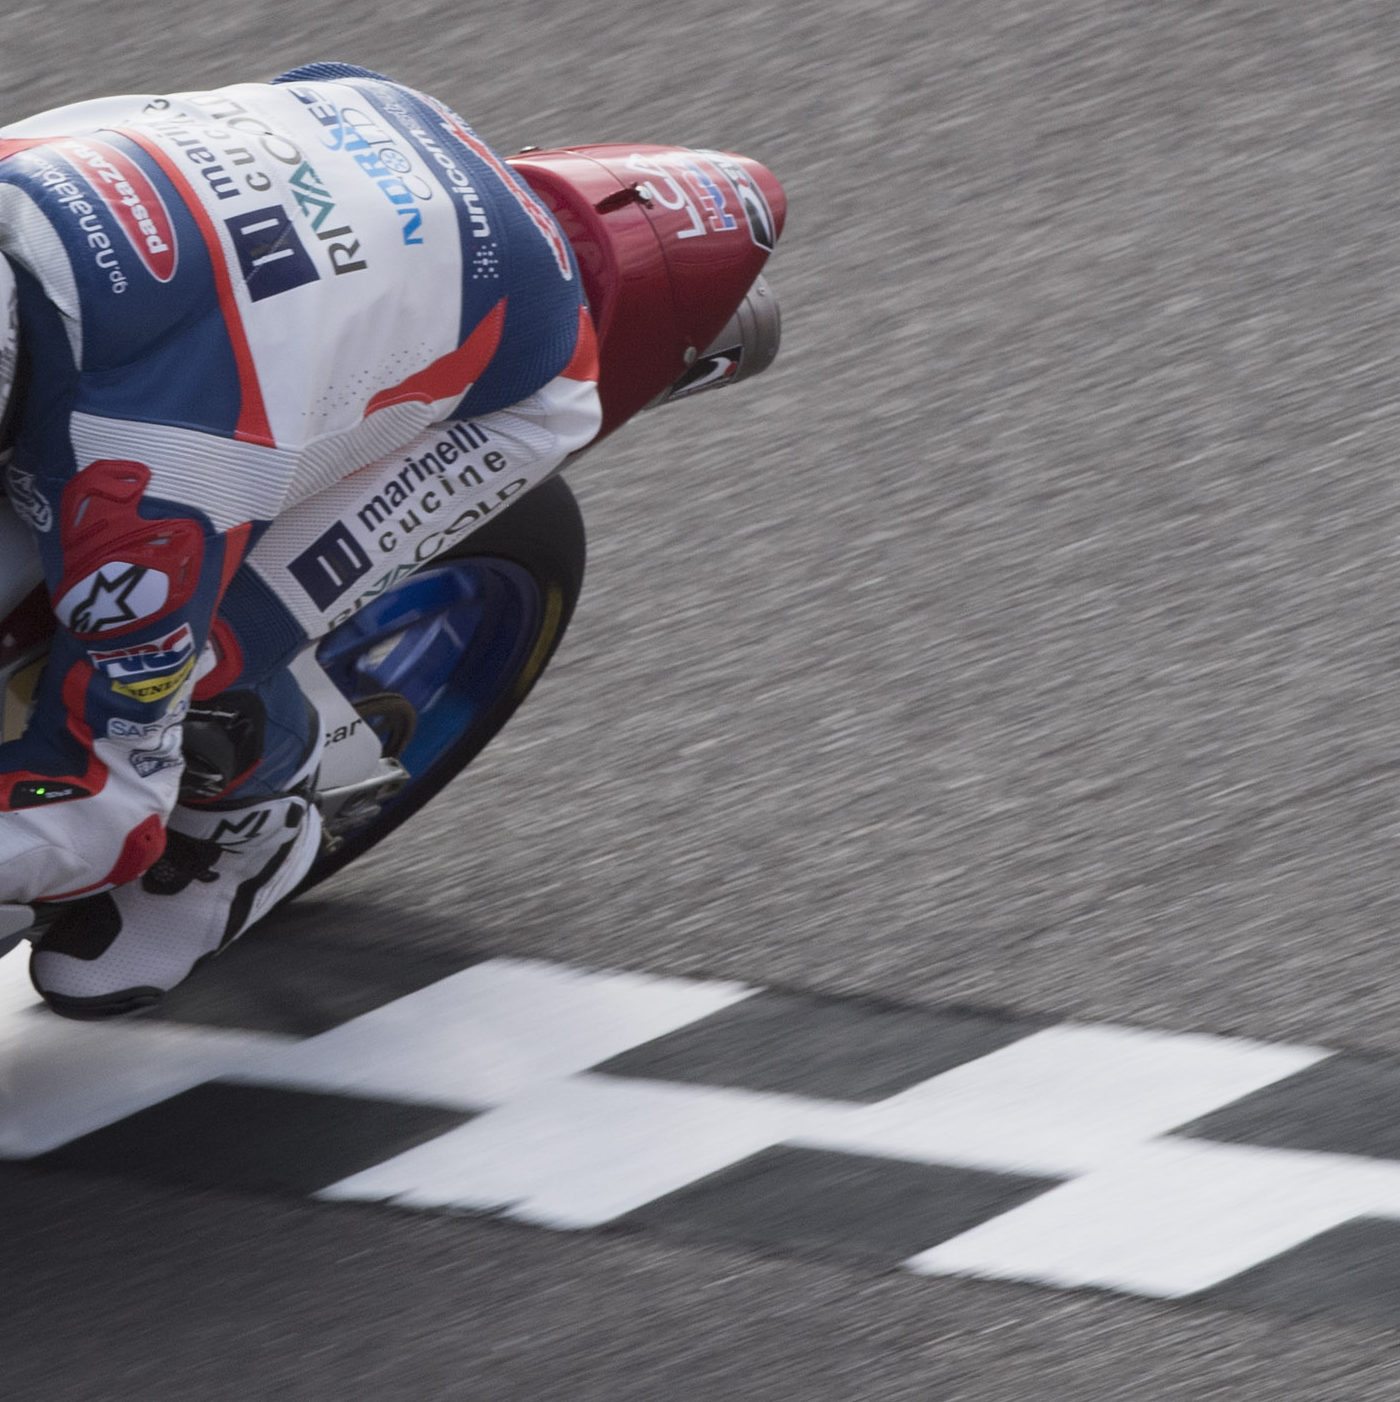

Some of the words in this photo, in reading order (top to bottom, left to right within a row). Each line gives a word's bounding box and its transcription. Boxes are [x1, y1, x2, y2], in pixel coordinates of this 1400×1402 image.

[410, 128, 490, 237] unicom
[356, 421, 491, 532] marinelli
[377, 450, 507, 553] cucine
